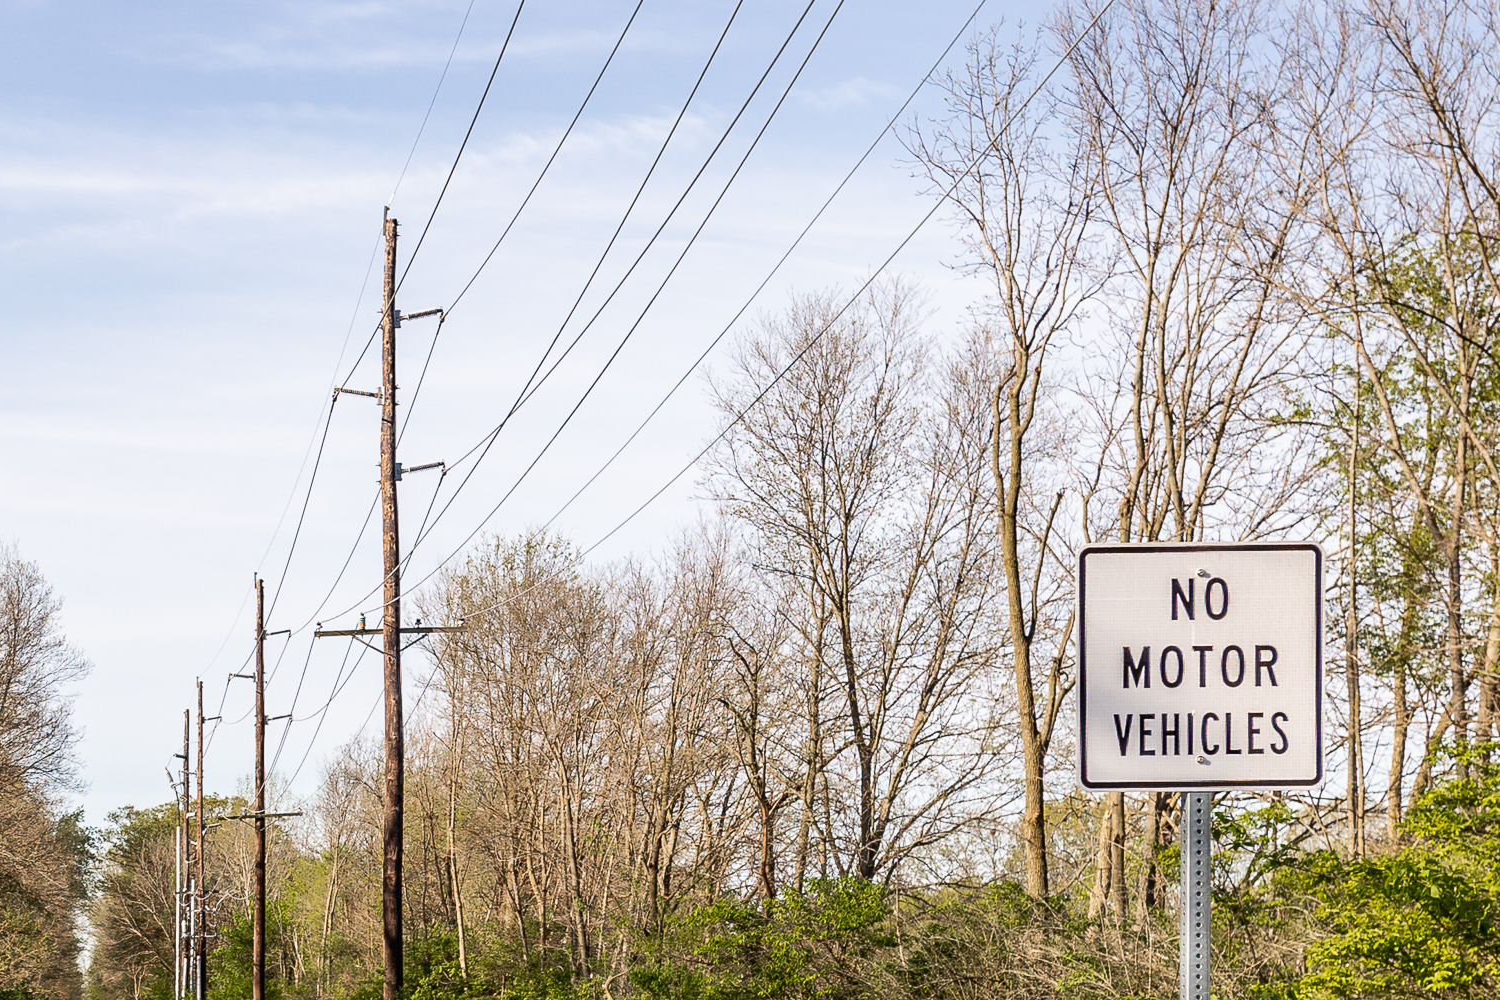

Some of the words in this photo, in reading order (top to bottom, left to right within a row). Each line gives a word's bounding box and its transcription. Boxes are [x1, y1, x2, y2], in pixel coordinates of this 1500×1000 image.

[1171, 577, 1229, 620] NO
[1122, 645, 1279, 688] MOTOR
[1113, 712, 1289, 756] VEHICLES
